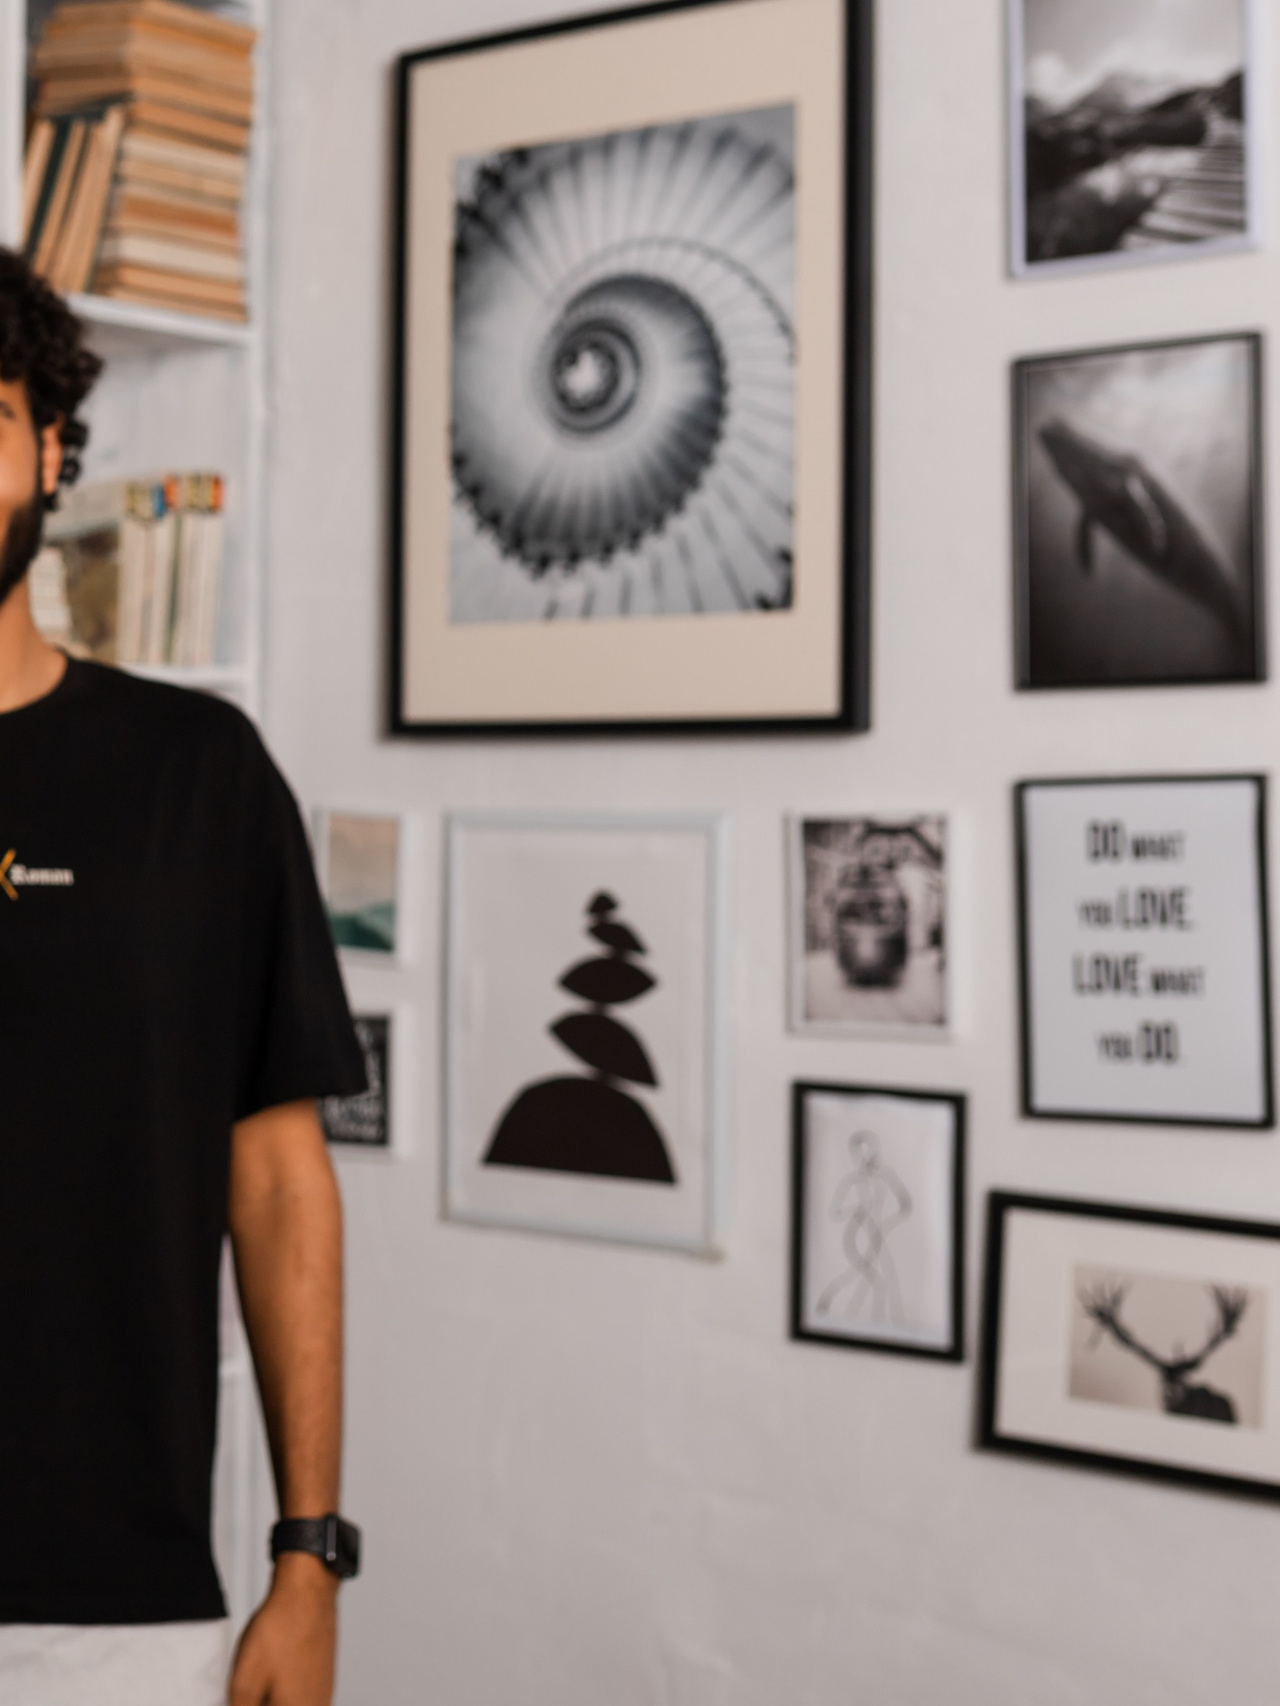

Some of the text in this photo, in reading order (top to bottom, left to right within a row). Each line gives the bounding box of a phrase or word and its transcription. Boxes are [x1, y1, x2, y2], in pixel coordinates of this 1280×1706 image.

[1085, 819, 1184, 862] DO WHAT
[1072, 952, 1206, 997] LOVE WHAT
